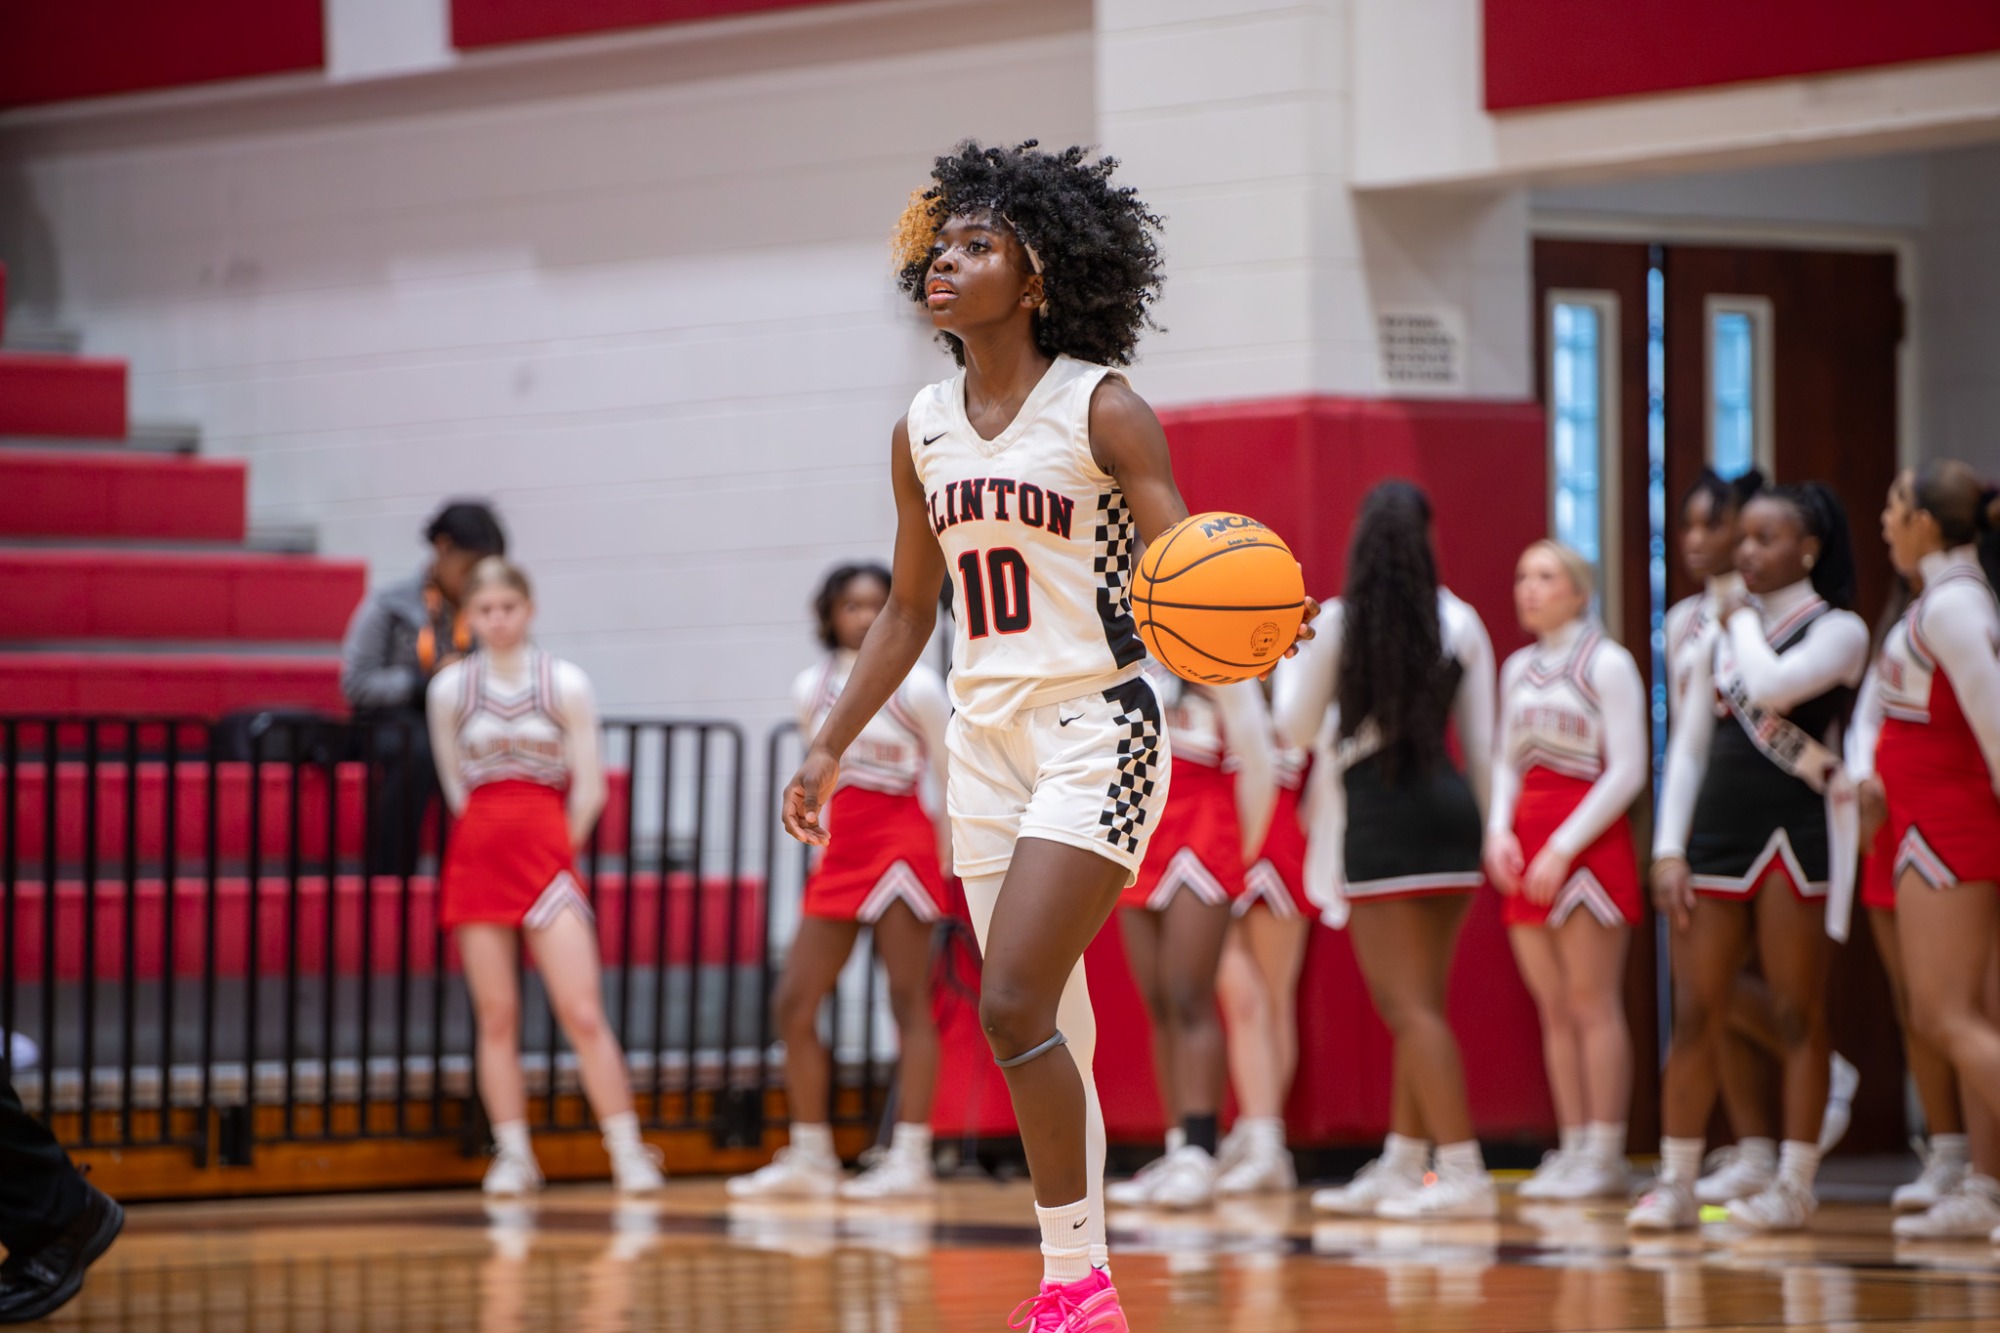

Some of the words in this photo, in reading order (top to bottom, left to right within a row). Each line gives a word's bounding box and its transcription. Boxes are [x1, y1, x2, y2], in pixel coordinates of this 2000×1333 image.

[927, 477, 1075, 541] LINTON
[1200, 516, 1267, 539] NCA
[958, 546, 1032, 641] 10
